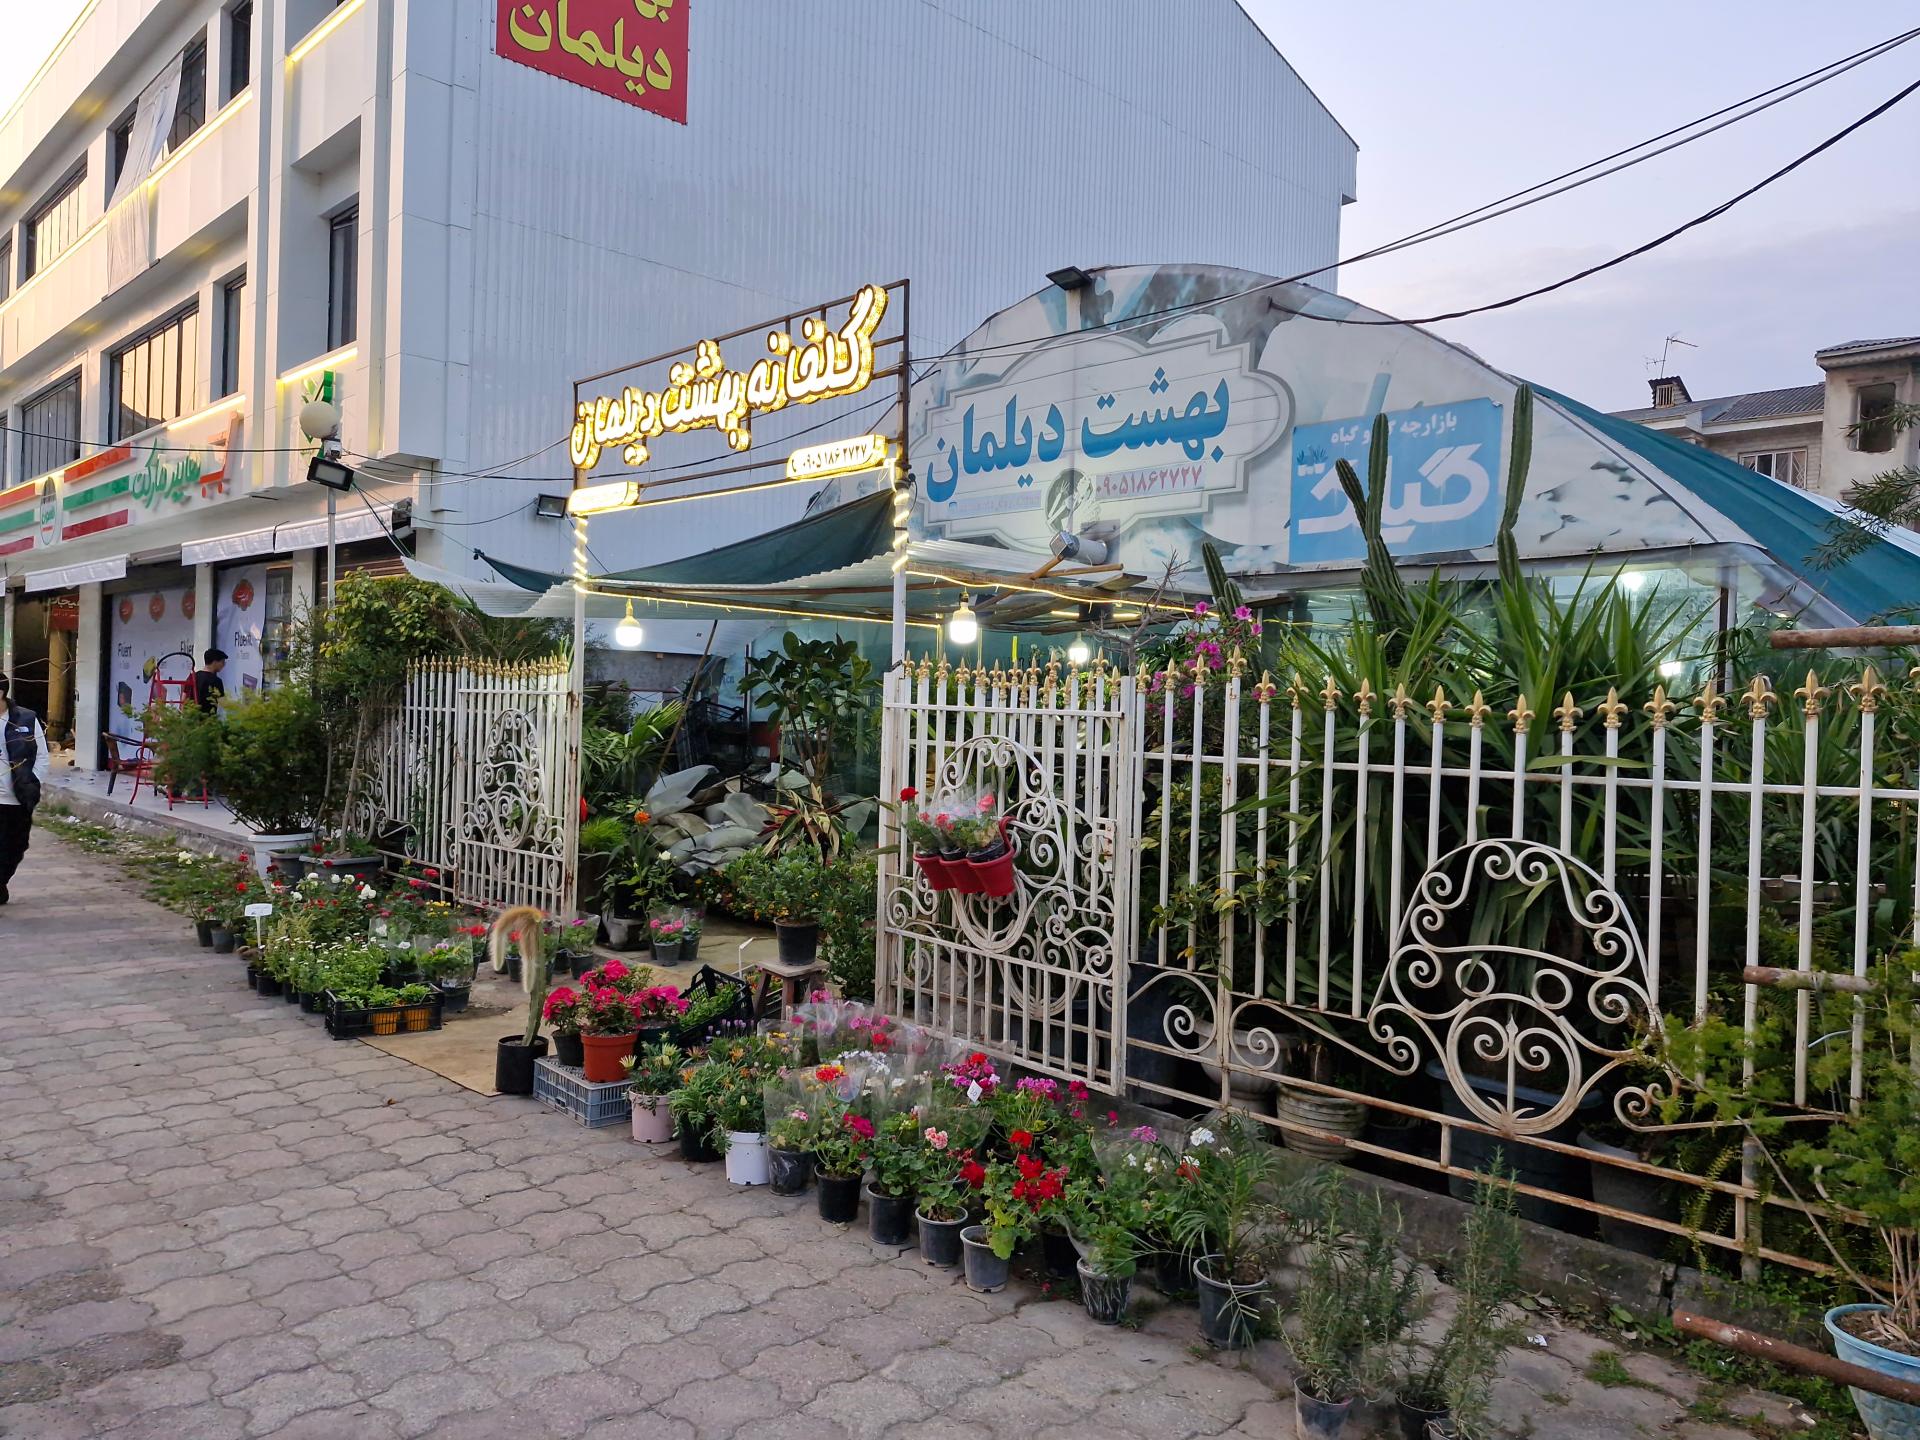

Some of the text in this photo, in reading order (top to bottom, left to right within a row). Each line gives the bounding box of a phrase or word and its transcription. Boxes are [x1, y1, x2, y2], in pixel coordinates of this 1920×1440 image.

[509, 0, 673, 96] دیلمان
[570, 284, 888, 469] گلخانه بهشت دیلمان
[1399, 410, 1458, 439] بازارچه
[926, 366, 1230, 502] بهشت دیلمان
[1330, 425, 1360, 446] گیاه
